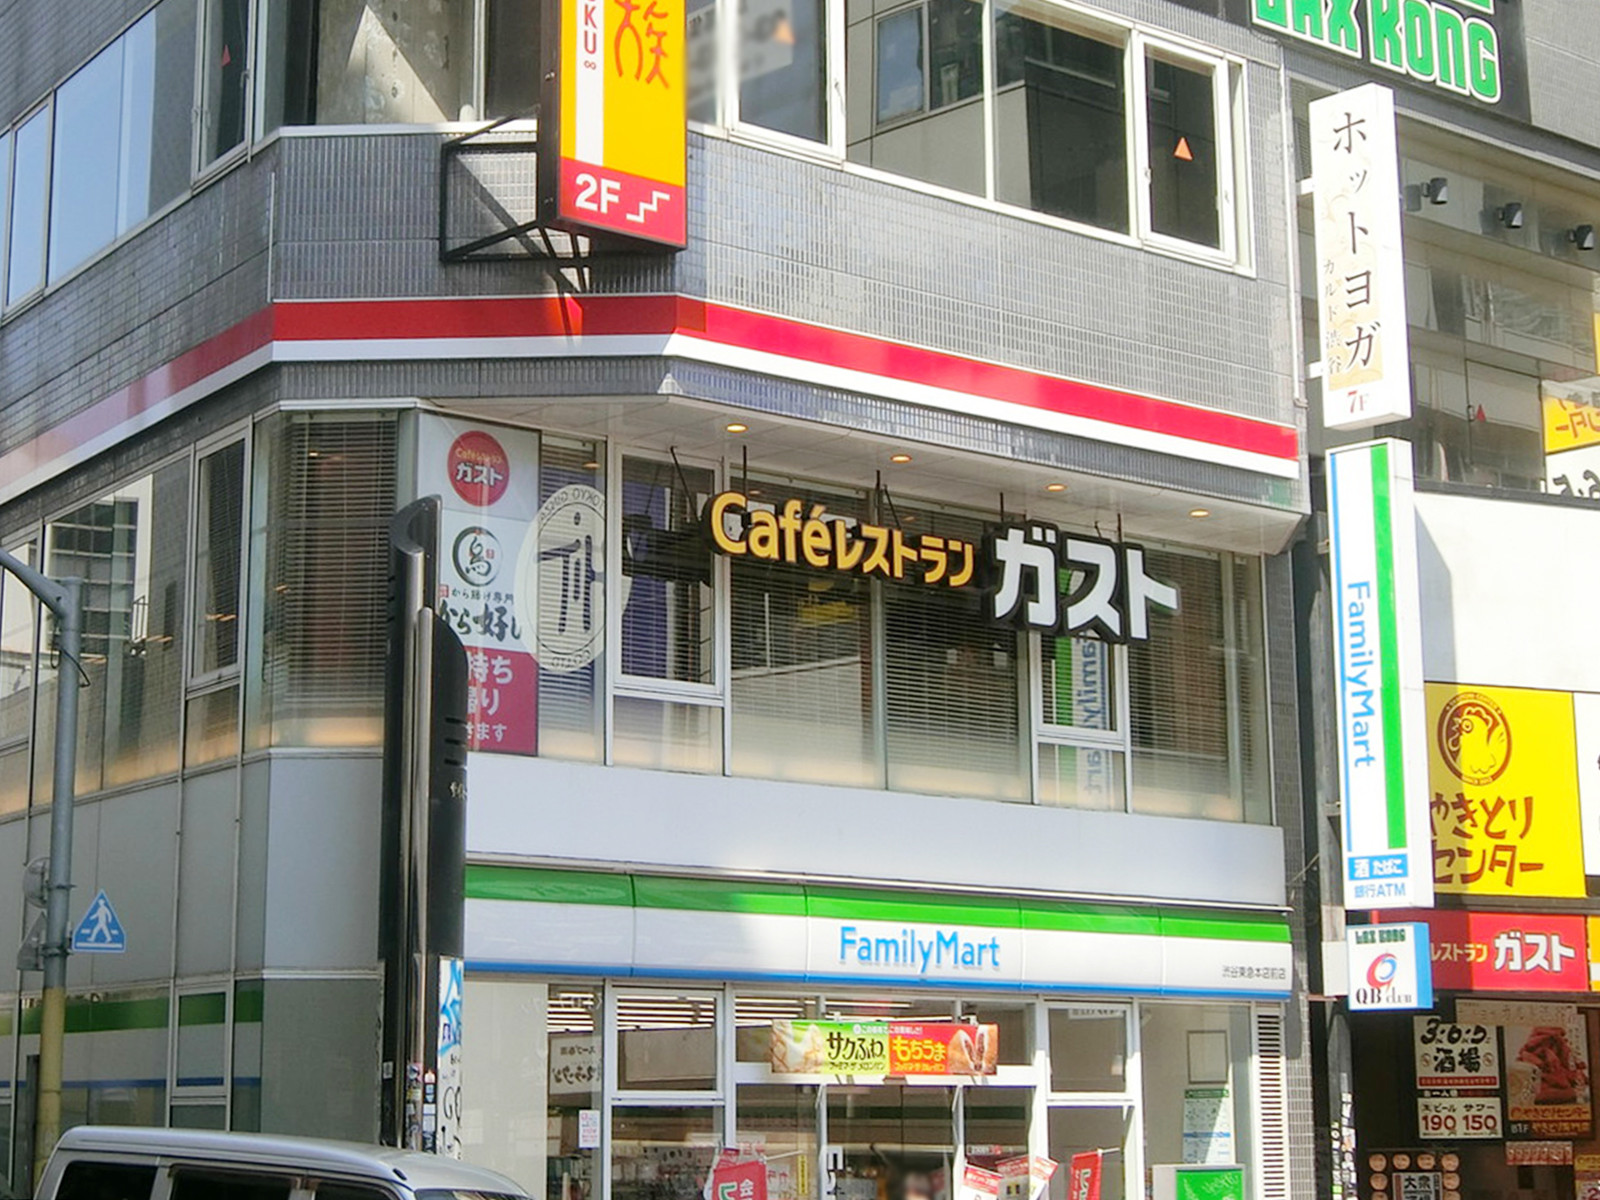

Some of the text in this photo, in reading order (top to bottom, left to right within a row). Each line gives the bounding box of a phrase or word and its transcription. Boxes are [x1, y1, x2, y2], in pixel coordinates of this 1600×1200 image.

[575, 173, 621, 213] 2F
[1333, 112, 1381, 370] ホットヨガ
[456, 461, 503, 486] ガスト
[995, 527, 1180, 640] ガスト
[1346, 581, 1376, 767] FamilyMart
[1431, 793, 1533, 840] やきとり
[840, 926, 1000, 973] FamilyMart
[1431, 931, 1575, 972] レストラン ガスト
[826, 1032, 884, 1060] サクふわ
[892, 1036, 946, 1062] もちうま
[1434, 1046, 1480, 1073] 酒場
[1422, 1115, 1497, 1131] 190 150
